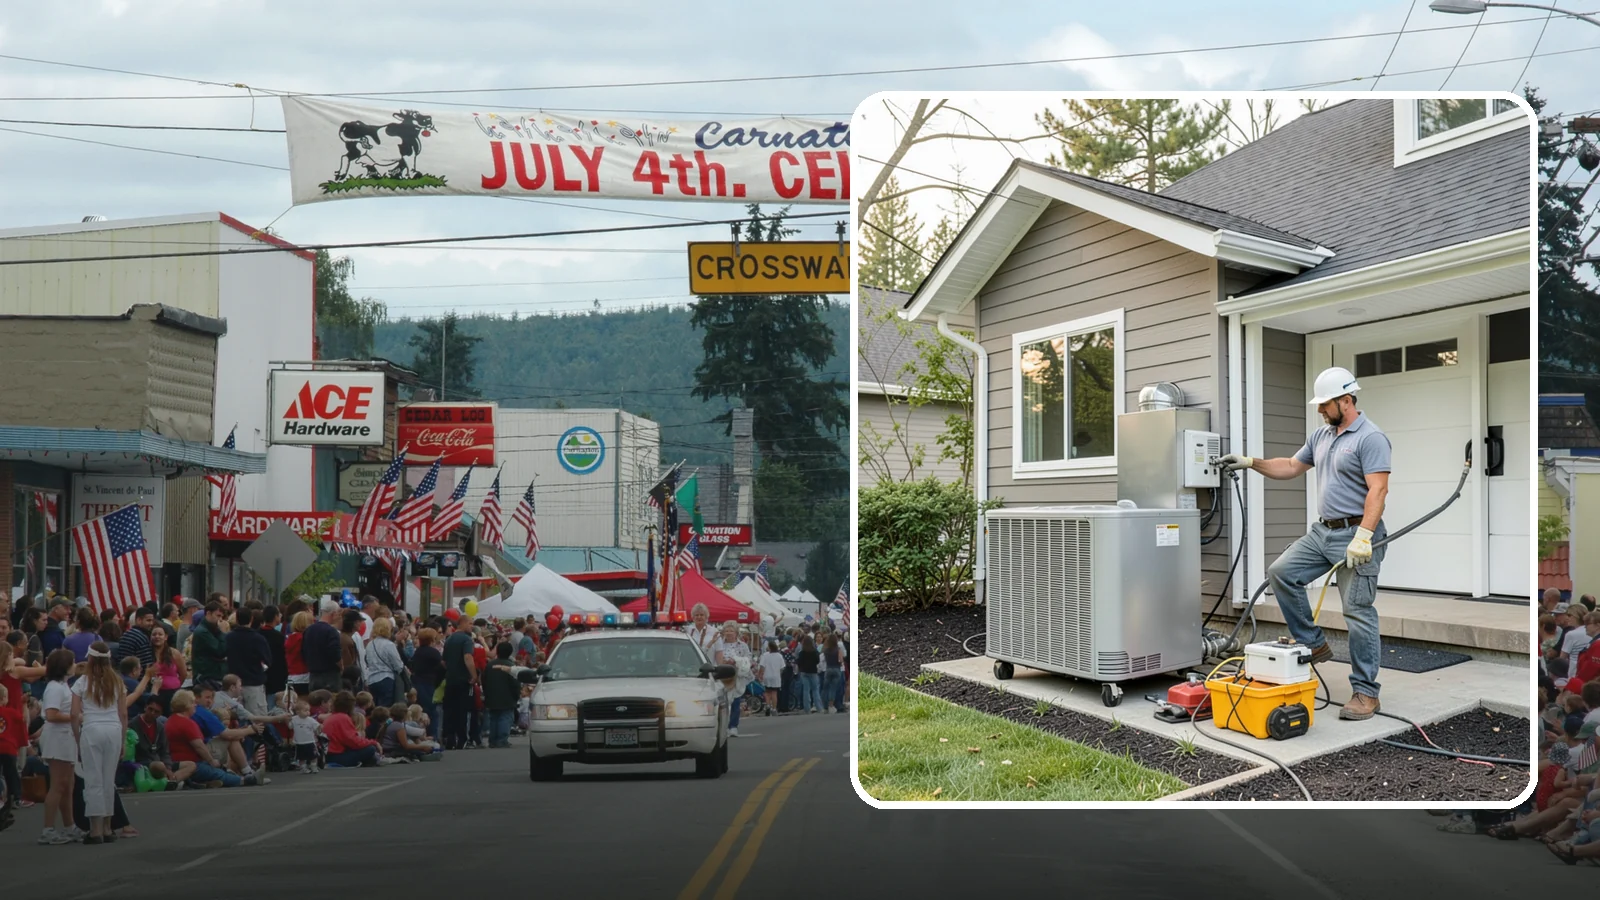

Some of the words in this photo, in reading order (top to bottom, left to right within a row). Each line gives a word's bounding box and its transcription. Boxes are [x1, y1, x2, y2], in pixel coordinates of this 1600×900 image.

[695, 121, 850, 150] Carnat
[481, 141, 605, 192] JULY
[632, 150, 747, 198] 4th.
[696, 254, 850, 280] CROSSWA
[283, 380, 373, 420] ACE
[405, 409, 452, 422] CEDAR
[283, 421, 370, 436] Hardware
[416, 428, 478, 447] Coca-Cola
[83, 485, 94, 495] St.
[96, 485, 124, 495] Vincent
[126, 485, 136, 495] de
[138, 486, 155, 495] Paul
[688, 526, 741, 536] CRNATION
[699, 535, 731, 543] GLASS
